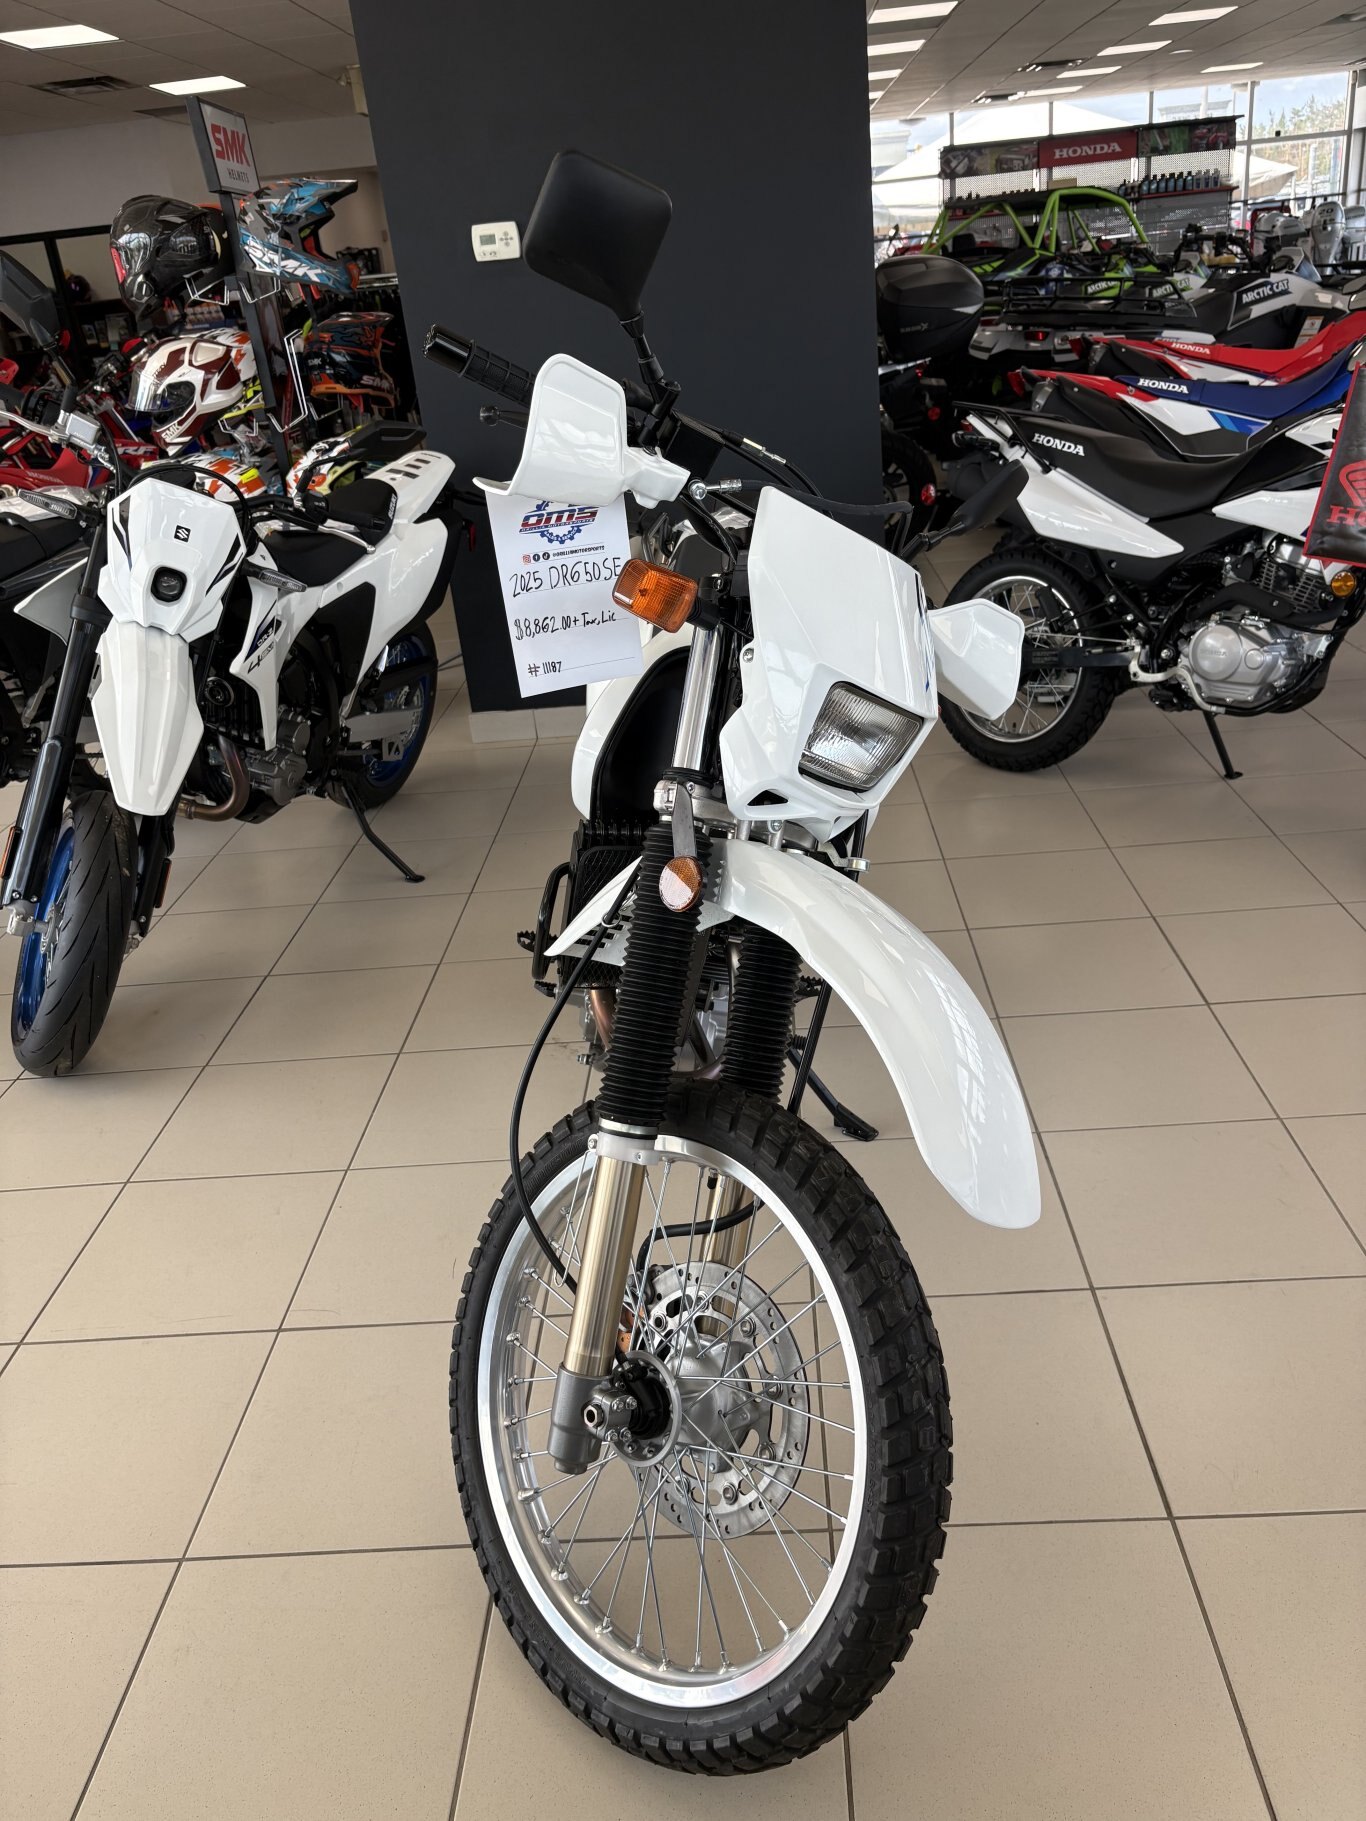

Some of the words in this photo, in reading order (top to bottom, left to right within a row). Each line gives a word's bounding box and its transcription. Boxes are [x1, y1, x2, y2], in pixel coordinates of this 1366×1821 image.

[210, 123, 251, 167] SMK
[1053, 142, 1122, 159] HONDA
[226, 167, 251, 184] HELMETS
[243, 238, 326, 283] SMK
[1152, 283, 1174, 298] ARCTI
[1177, 279, 1191, 288] CAT
[1241, 284, 1273, 304] ARCTIC
[1272, 279, 1289, 293] CAT
[1170, 342, 1211, 355] HONDA
[1137, 377, 1189, 394] HONDA
[161, 421, 181, 441] SMK
[1032, 432, 1085, 457] HONDA
[521, 507, 599, 528] OMS
[509, 571, 543, 598] 2025
